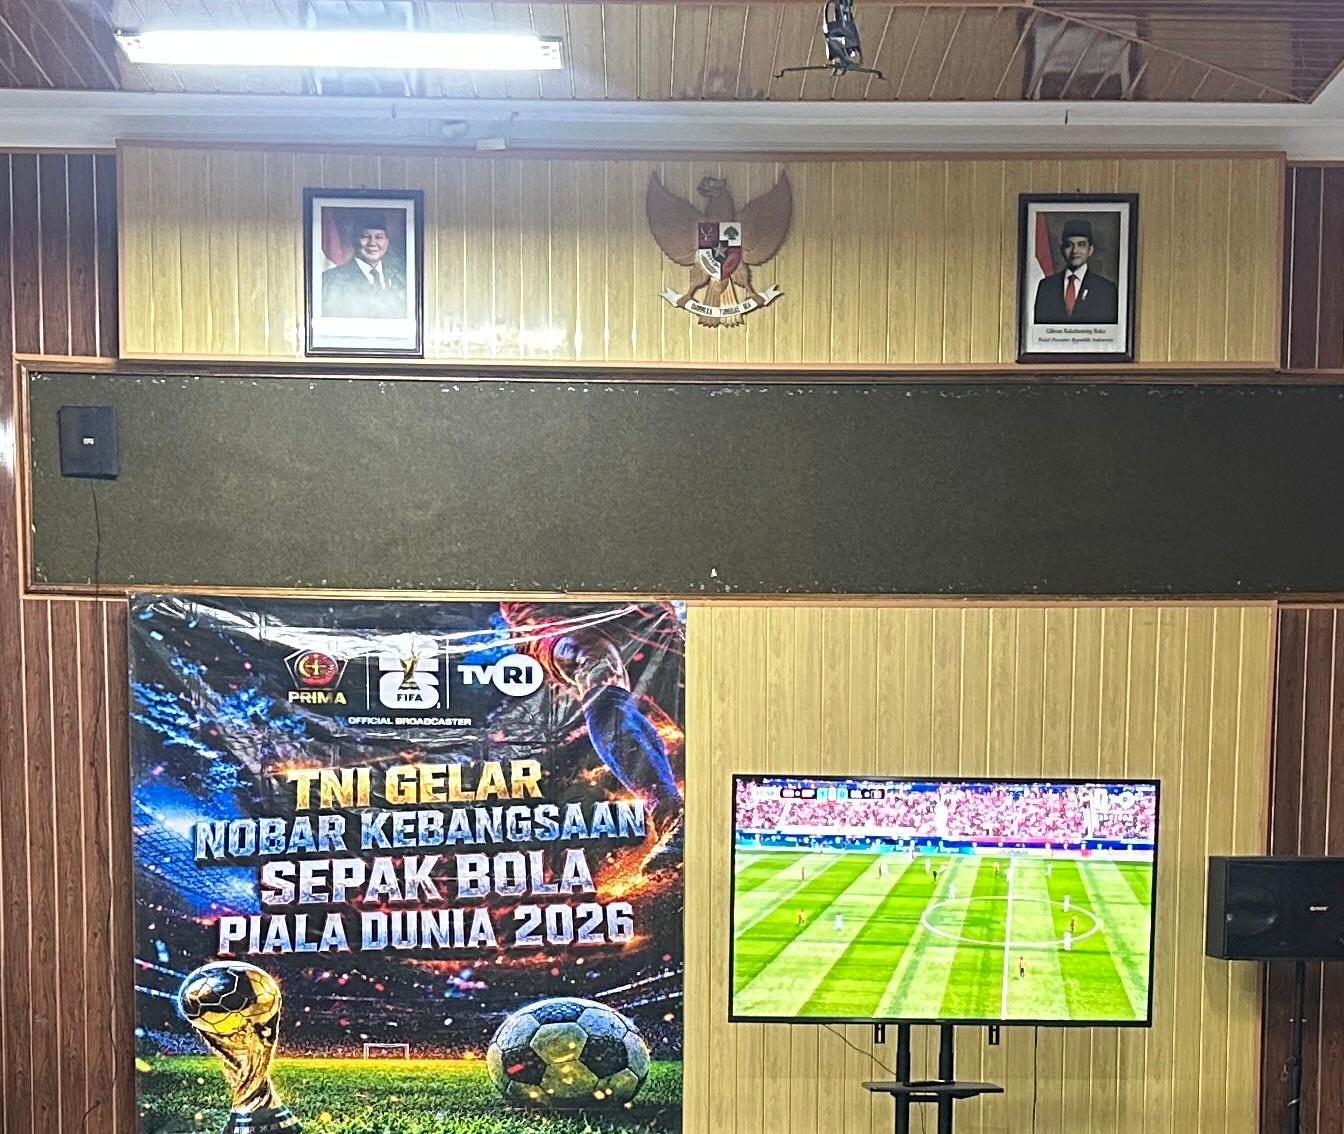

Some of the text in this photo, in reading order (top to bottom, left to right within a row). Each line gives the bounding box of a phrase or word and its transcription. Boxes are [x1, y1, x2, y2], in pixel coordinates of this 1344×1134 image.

[457, 665, 533, 685] TVRI
[288, 691, 346, 704] PRIMA
[397, 693, 423, 702] FIFA
[348, 717, 472, 726] OFFICIAL BROADCASTER
[287, 759, 543, 811] TNI GELAR
[194, 800, 646, 862] NOBAR KEBANGSAAN
[260, 847, 597, 907] SEPAK BOLA
[218, 902, 634, 956] PIALA DUNIA 2026
